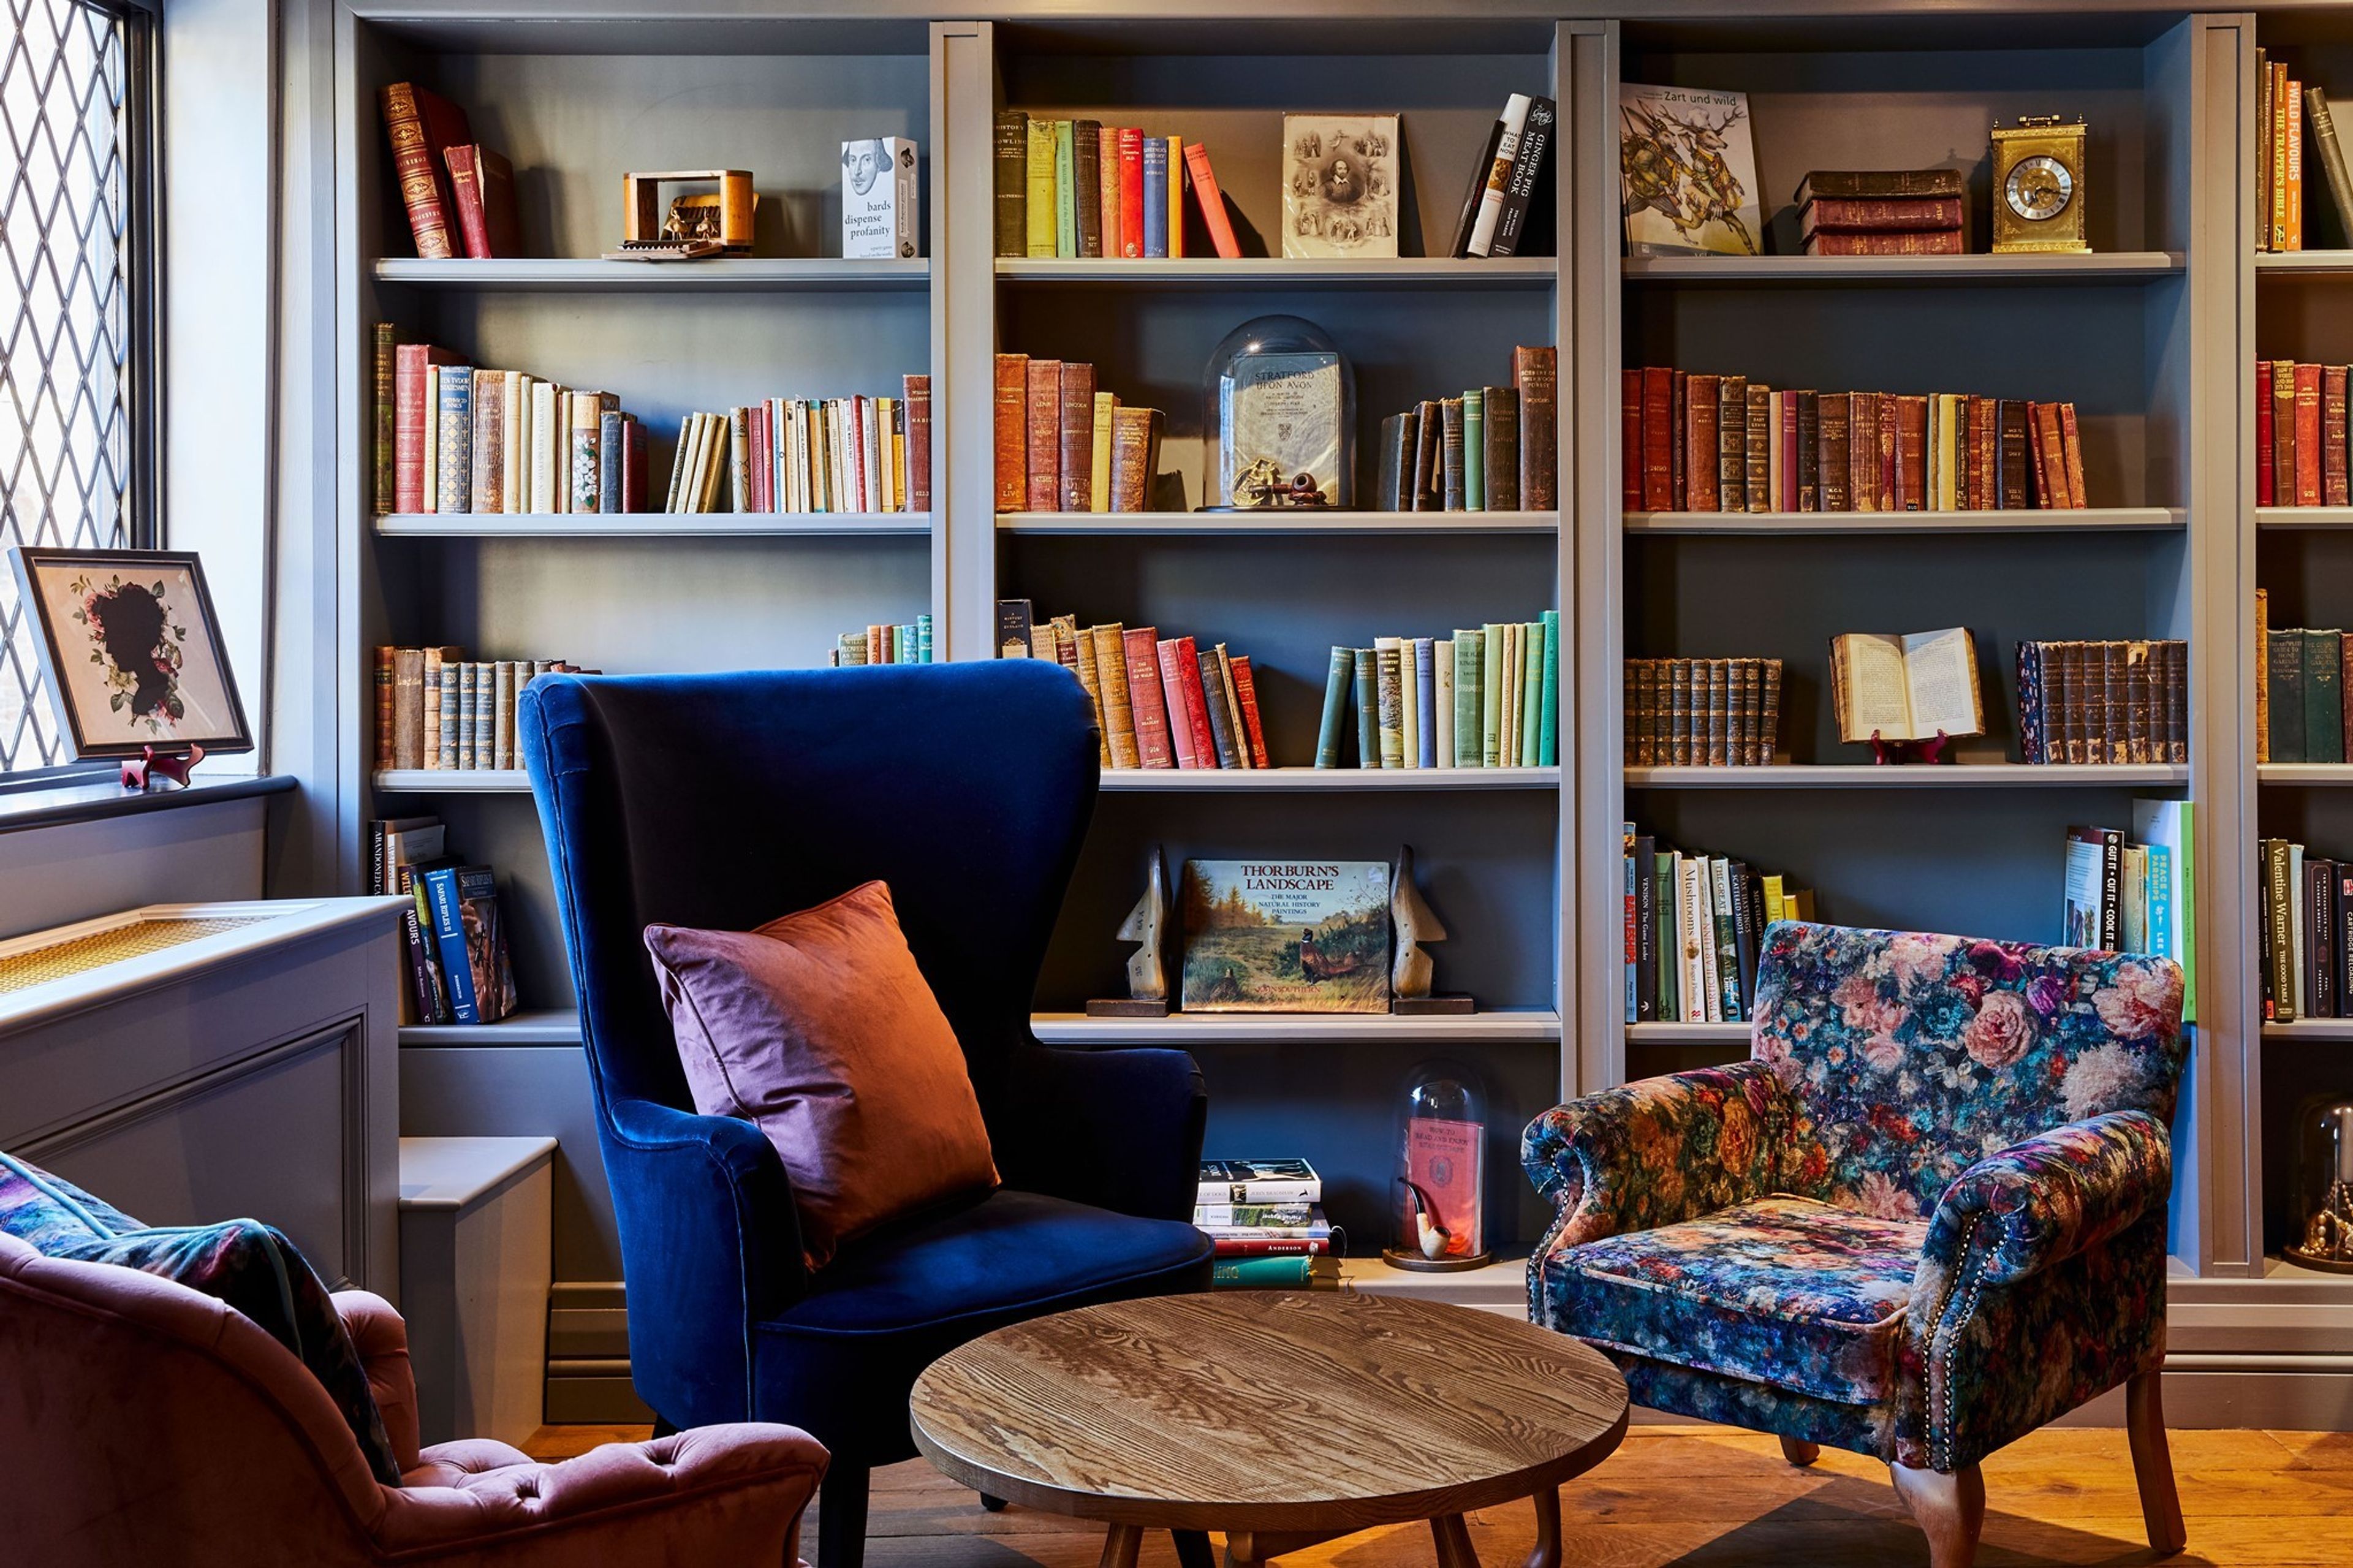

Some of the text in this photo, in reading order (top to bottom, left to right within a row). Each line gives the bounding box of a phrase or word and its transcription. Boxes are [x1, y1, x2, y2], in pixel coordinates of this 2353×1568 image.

[1664, 91, 1686, 102] Zart
[1690, 94, 1710, 104] und
[1713, 97, 1737, 106] wild
[2289, 89, 2300, 181] WILD FLAVOURS
[1510, 131, 1536, 194] MEAT BOOK
[1521, 134, 1545, 197] GINGER PIG
[2276, 108, 2285, 218] THE TRAPPER'S BIBLE
[867, 200, 891, 211] bards
[844, 214, 882, 226] dispense
[851, 226, 890, 240] profanity
[1255, 371, 1314, 380] STRATFORD
[1256, 381, 1282, 390] UPON
[2108, 846, 2117, 861] GUT
[1241, 865, 1339, 877] THORBURN'S
[1246, 879, 1335, 890] LANDSCAPE
[2274, 847, 2285, 900] Valentine
[1717, 882, 1726, 911] GREAT
[1732, 874, 1741, 912] SCATTERED
[2107, 878, 2116, 893] CUT
[1684, 869, 1696, 936] Mushrooms
[1742, 890, 1751, 933] HASTINGS
[406, 909, 420, 945] AVOURS
[1625, 895, 1636, 965] BATTLESHIPS
[2106, 909, 2115, 931] COOK
[2275, 902, 2286, 945] Warner
[1702, 923, 1711, 950] LUNN
[1705, 952, 1716, 1013] PARTICULAR
[1449, 1137, 1468, 1146] ENJOY
